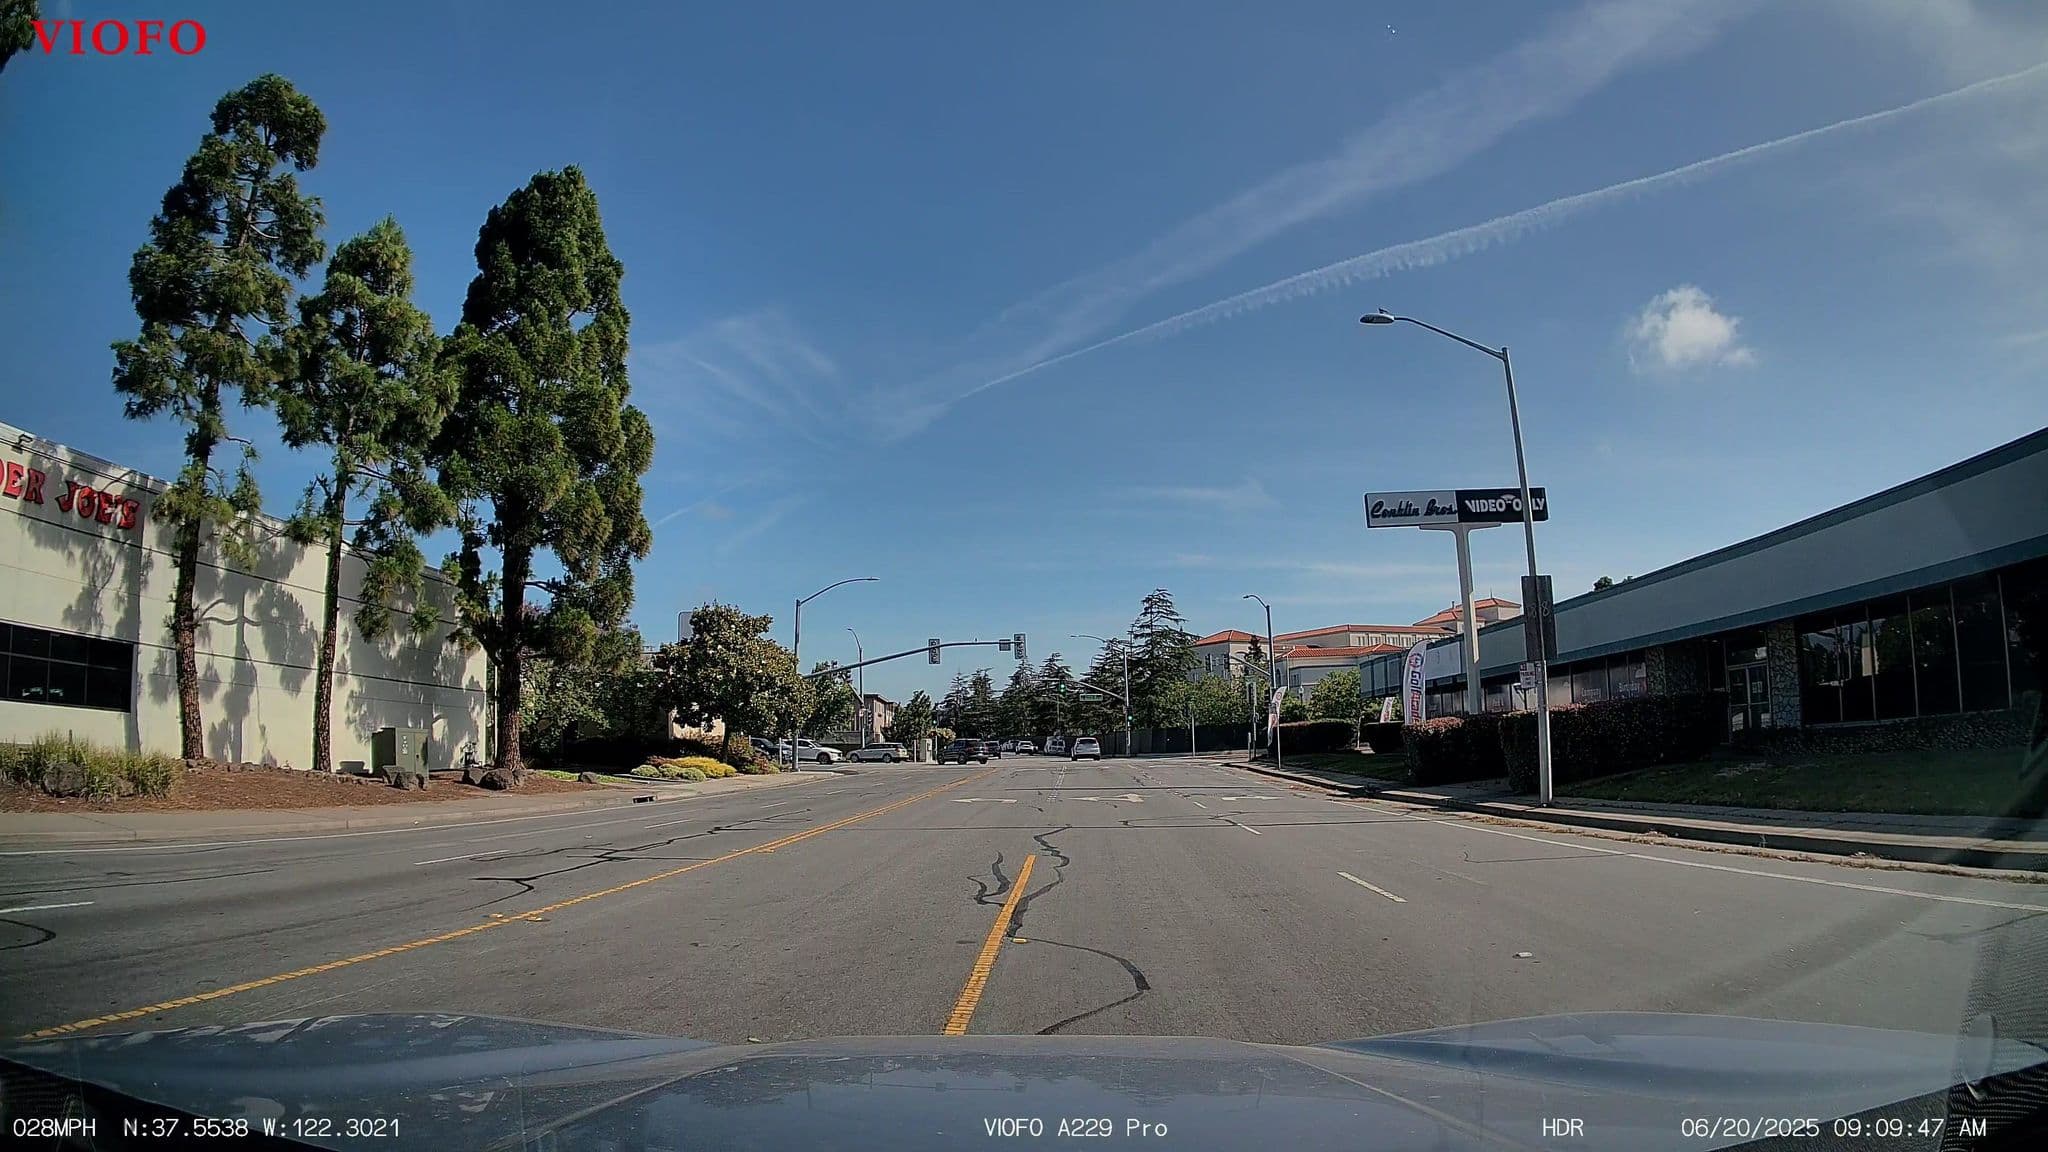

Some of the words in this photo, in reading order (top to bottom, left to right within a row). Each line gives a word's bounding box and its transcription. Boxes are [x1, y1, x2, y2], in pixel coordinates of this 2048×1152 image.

[0, 459, 45, 504] ER
[55, 480, 140, 530] JOE'S
[1370, 499, 1420, 519] Conklin
[1465, 499, 1506, 513] VIDEO
[1513, 497, 1545, 512] OLY
